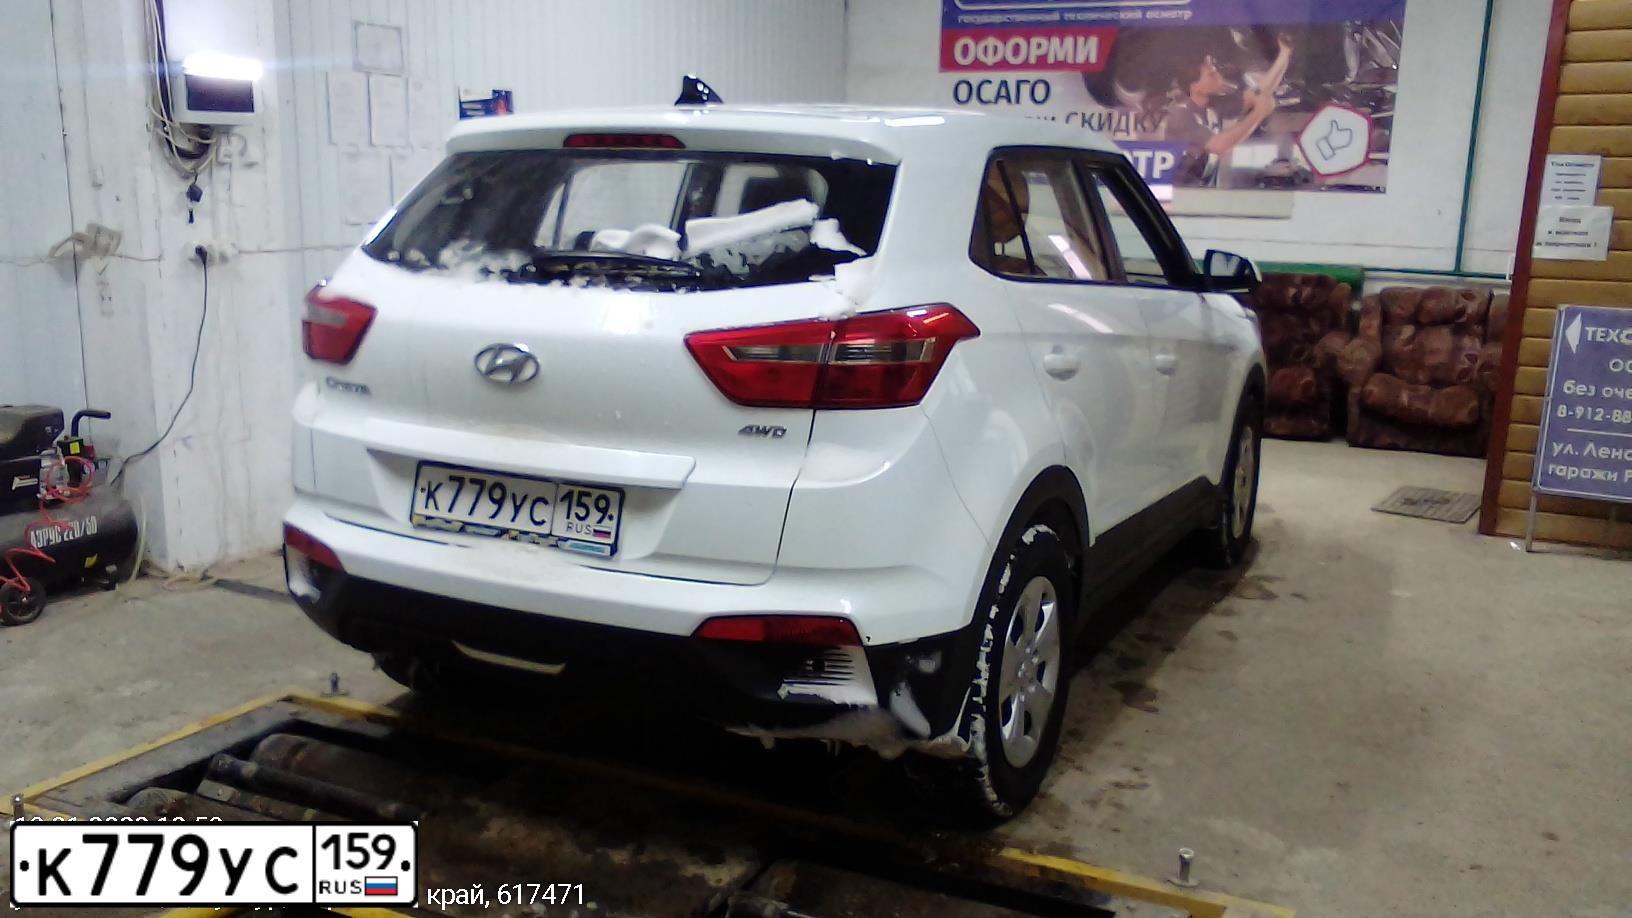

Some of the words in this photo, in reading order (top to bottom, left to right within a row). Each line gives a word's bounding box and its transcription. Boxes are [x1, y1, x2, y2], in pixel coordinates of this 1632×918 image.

[954, 36, 1099, 66] ОФОРМИ
[953, 79, 1051, 105] ОСАГО
[1563, 380, 1596, 396] без
[1548, 464, 1618, 482] гаражи
[424, 475, 549, 526] К779УС
[560, 489, 611, 524] 159
[566, 521, 592, 535] RUS
